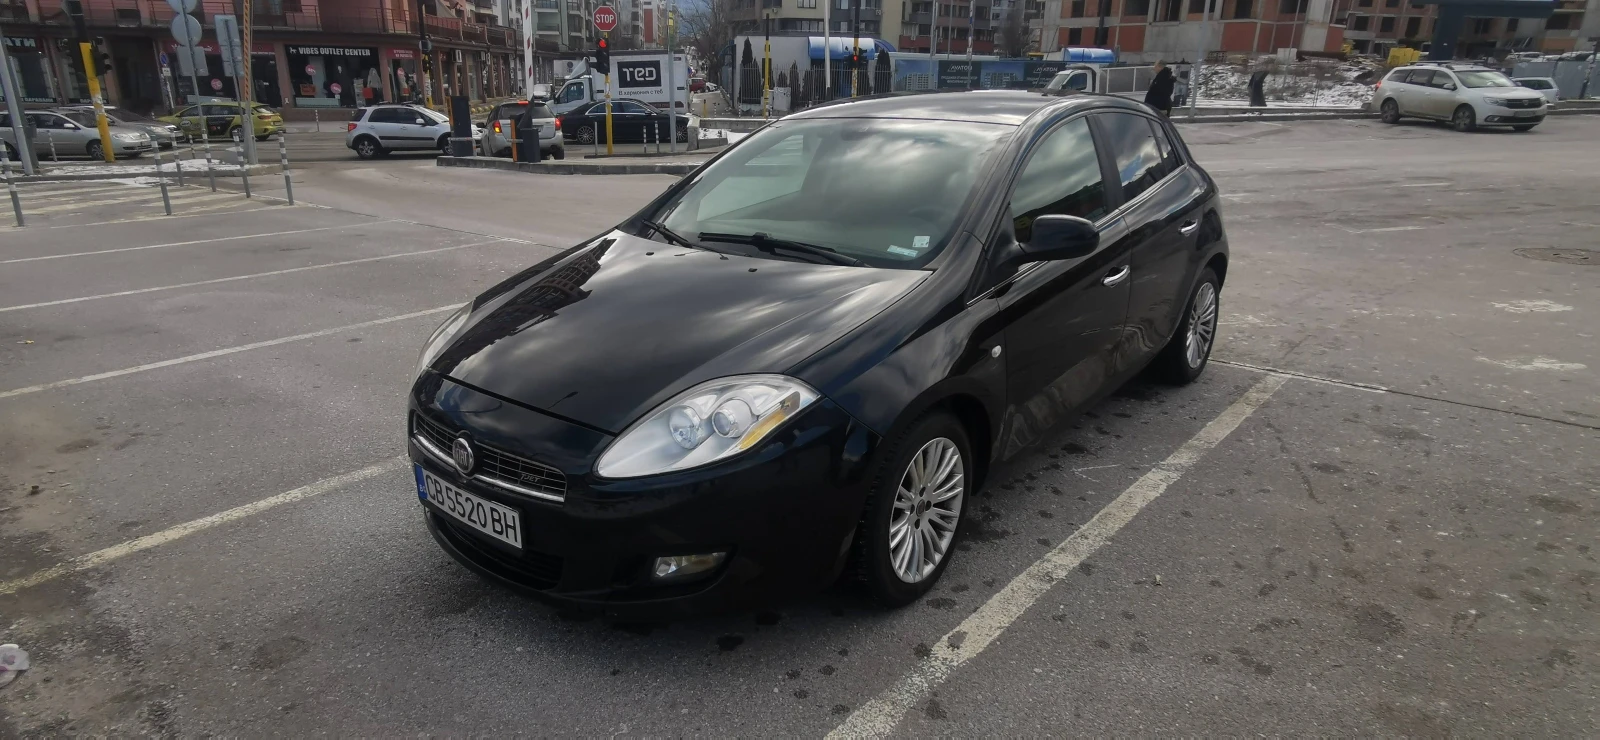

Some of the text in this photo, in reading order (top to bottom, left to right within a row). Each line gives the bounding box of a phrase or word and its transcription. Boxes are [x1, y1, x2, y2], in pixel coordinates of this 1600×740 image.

[595, 14, 615, 24] STOP
[298, 47, 371, 56] VIBES OUTLET CENTER
[455, 448, 468, 467] FIAT
[426, 474, 518, 543] CB 5520 BH
